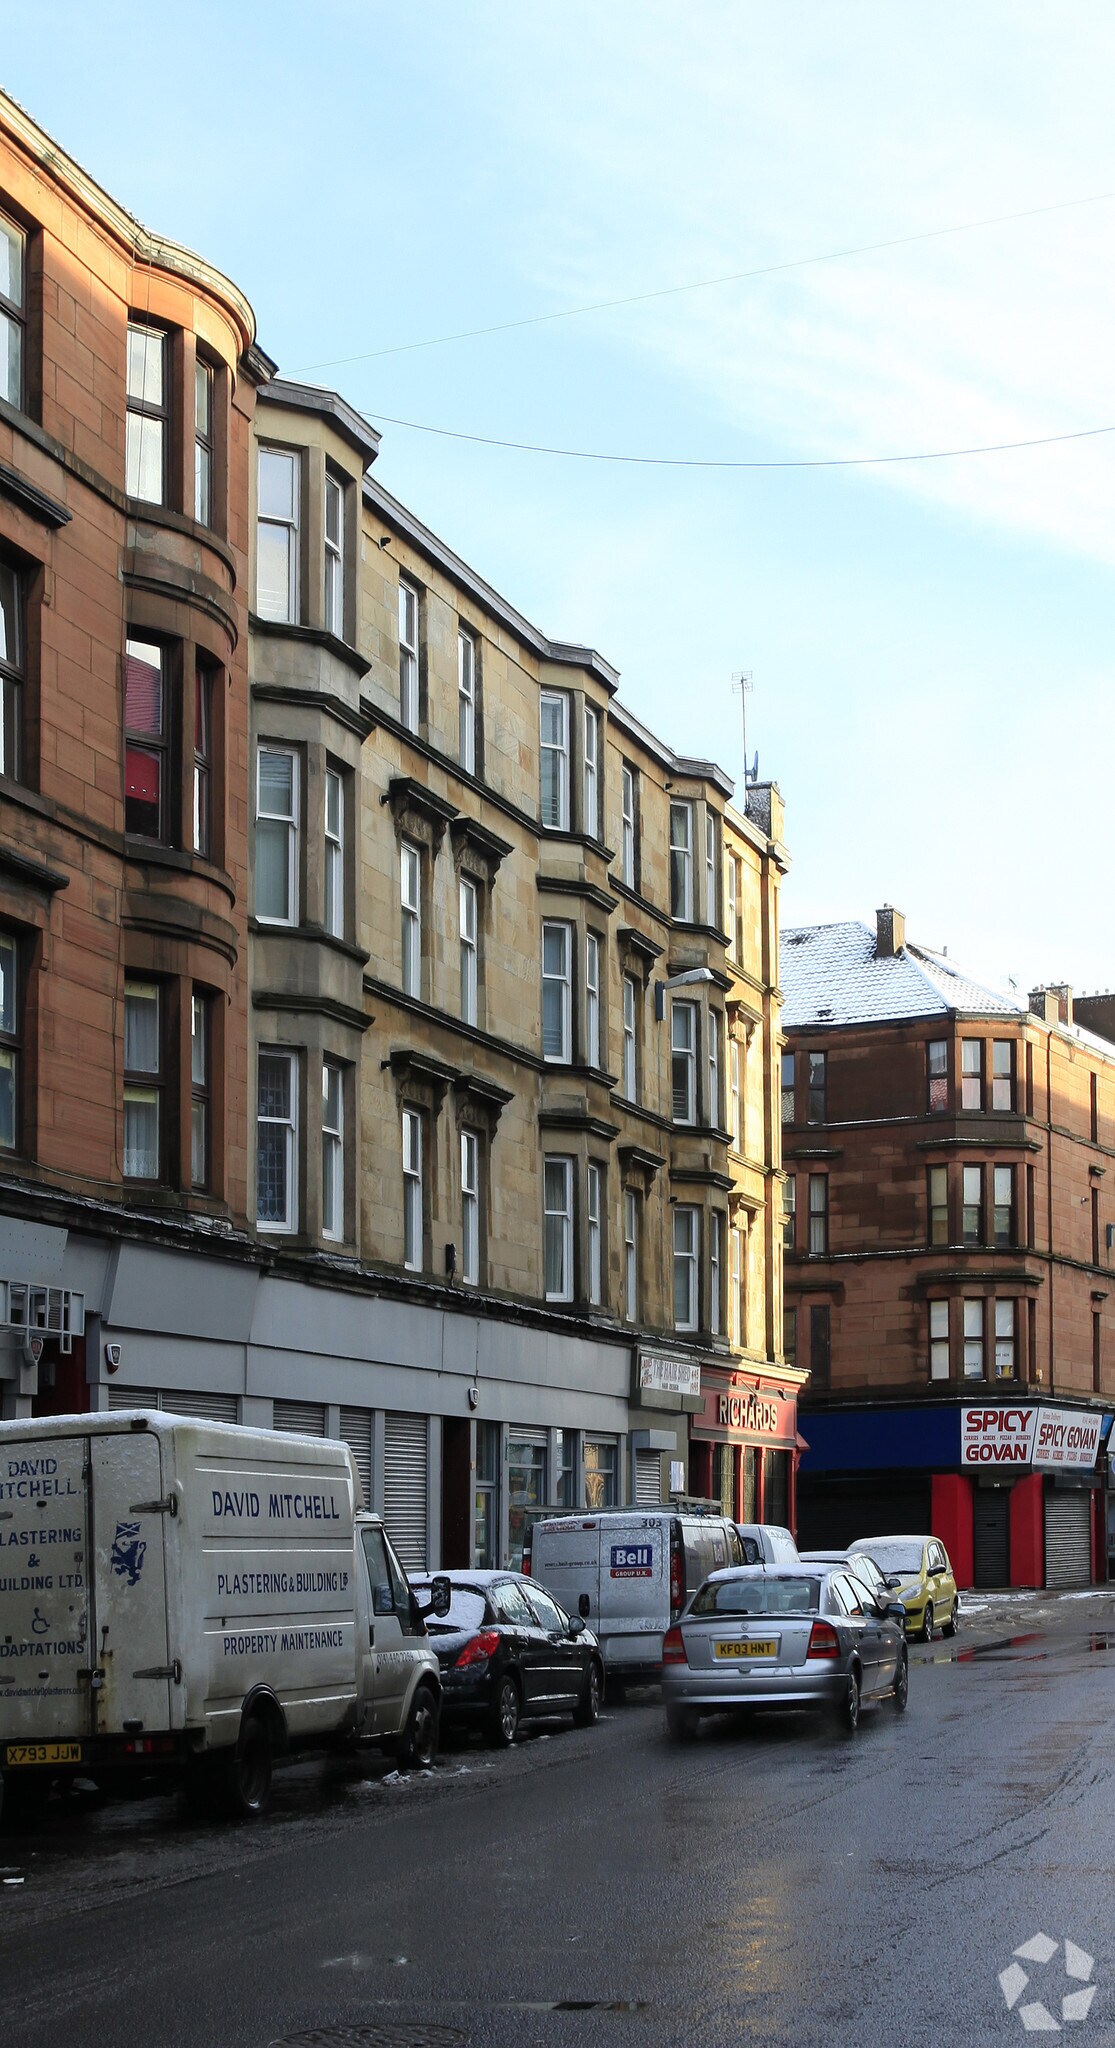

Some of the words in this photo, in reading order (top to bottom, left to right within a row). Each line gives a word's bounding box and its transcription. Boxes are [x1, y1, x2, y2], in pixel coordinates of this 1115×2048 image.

[653, 1359, 663, 1379] THE
[664, 1362, 677, 1380] HAIR
[679, 1365, 691, 1382] SHED
[717, 1394, 778, 1432] RICHARDS
[966, 1410, 1033, 1432] SPICY
[1039, 1423, 1067, 1447] SPICY
[1068, 1427, 1097, 1450] GOVAN
[965, 1443, 1027, 1462] GOVAN
[8, 1458, 58, 1477] DAVID
[0, 1478, 81, 1499] ITCHELL.
[212, 1491, 260, 1517] DAVID
[268, 1493, 340, 1520] MITCHELL
[641, 1518, 662, 1528] 303
[0, 1528, 82, 1547] LASTERING
[27, 1553, 41, 1568] &
[616, 1549, 648, 1565] Bell
[0, 1576, 53, 1591] UILDING
[217, 1573, 288, 1595] PLASTERING
[288, 1576, 295, 1591] &
[296, 1572, 338, 1592] BUILDING
[0, 1641, 84, 1658] DAPTATIONS
[223, 1634, 278, 1656] PROPERTY
[280, 1630, 343, 1652] MAINTENANCE
[720, 1643, 748, 1655] KF03
[750, 1642, 771, 1654] HNT
[8, 1746, 47, 1762] X793
[51, 1745, 79, 1760] JJW
